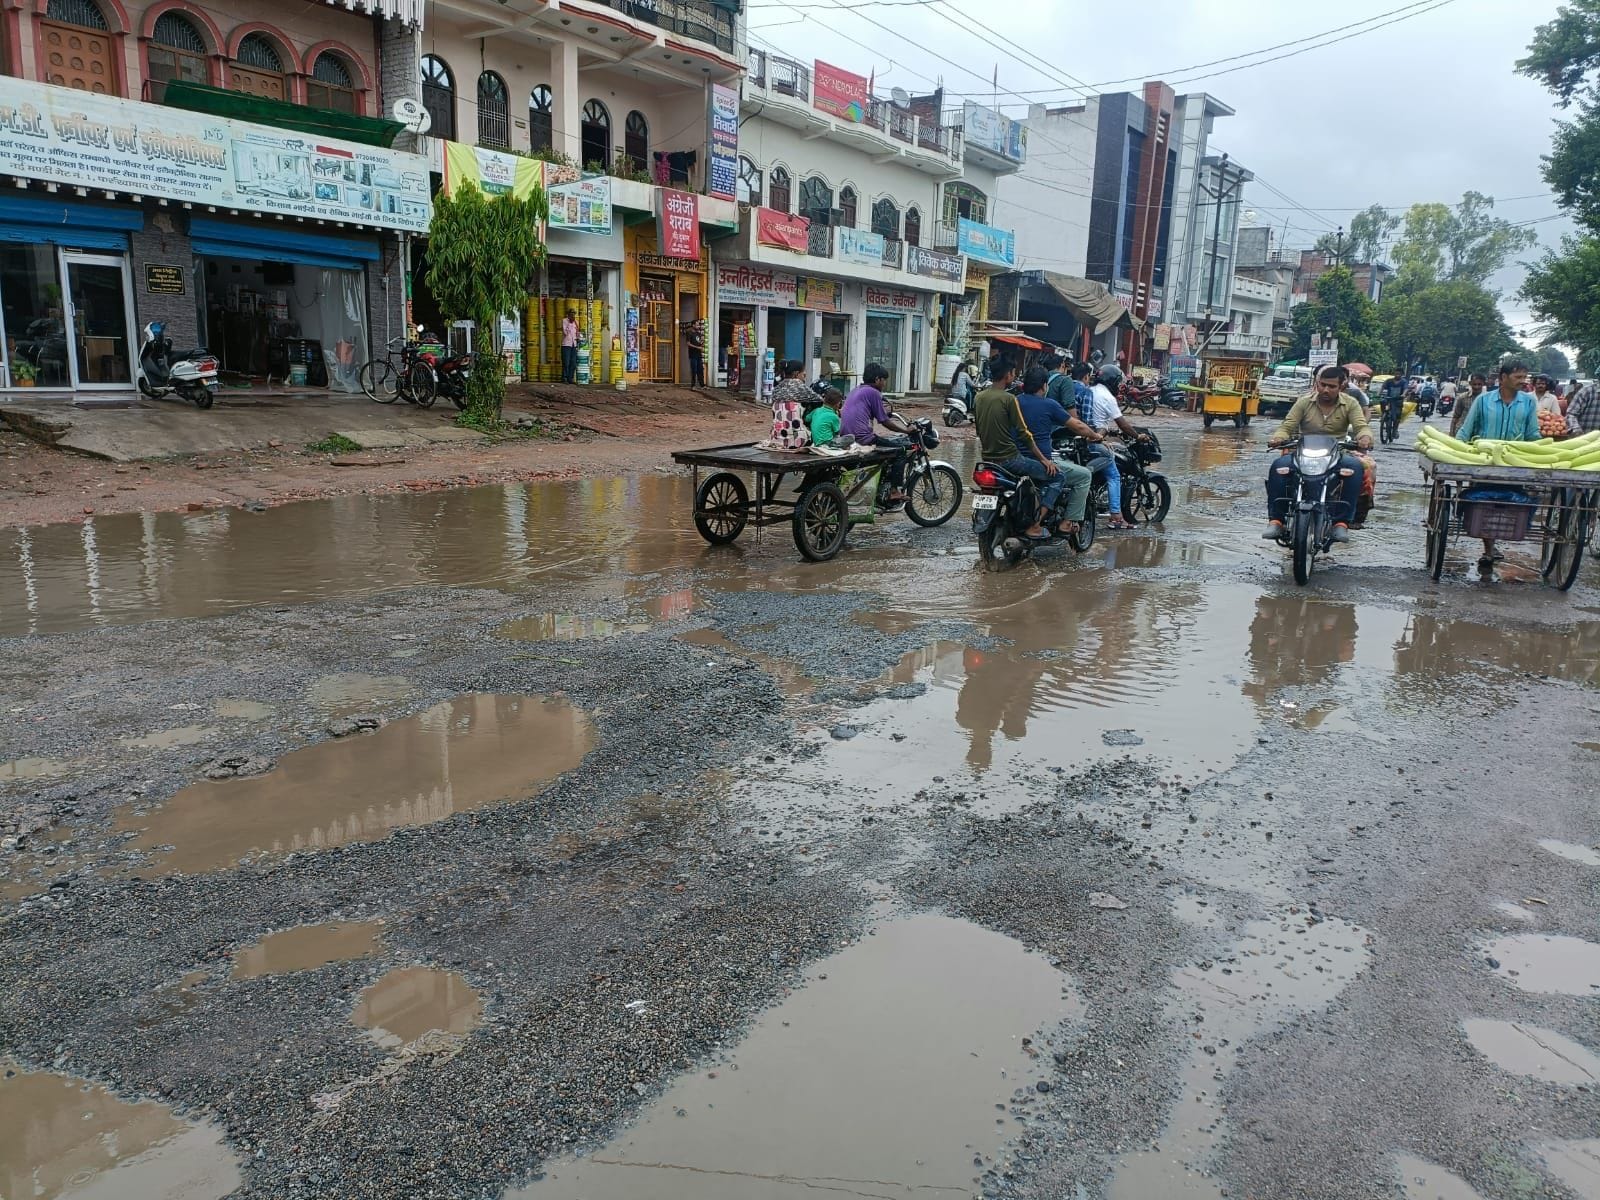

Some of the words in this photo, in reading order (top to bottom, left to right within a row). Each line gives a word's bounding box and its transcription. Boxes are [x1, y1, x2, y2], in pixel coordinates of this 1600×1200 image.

[713, 114, 737, 135] तिवारी
[667, 194, 694, 216] अंग्रेजी
[669, 214, 693, 232] शराब
[919, 251, 939, 269] विवेक
[719, 266, 750, 288] उन्नति
[750, 268, 774, 292] ट्रेडर्स
[867, 287, 890, 305] विवेक
